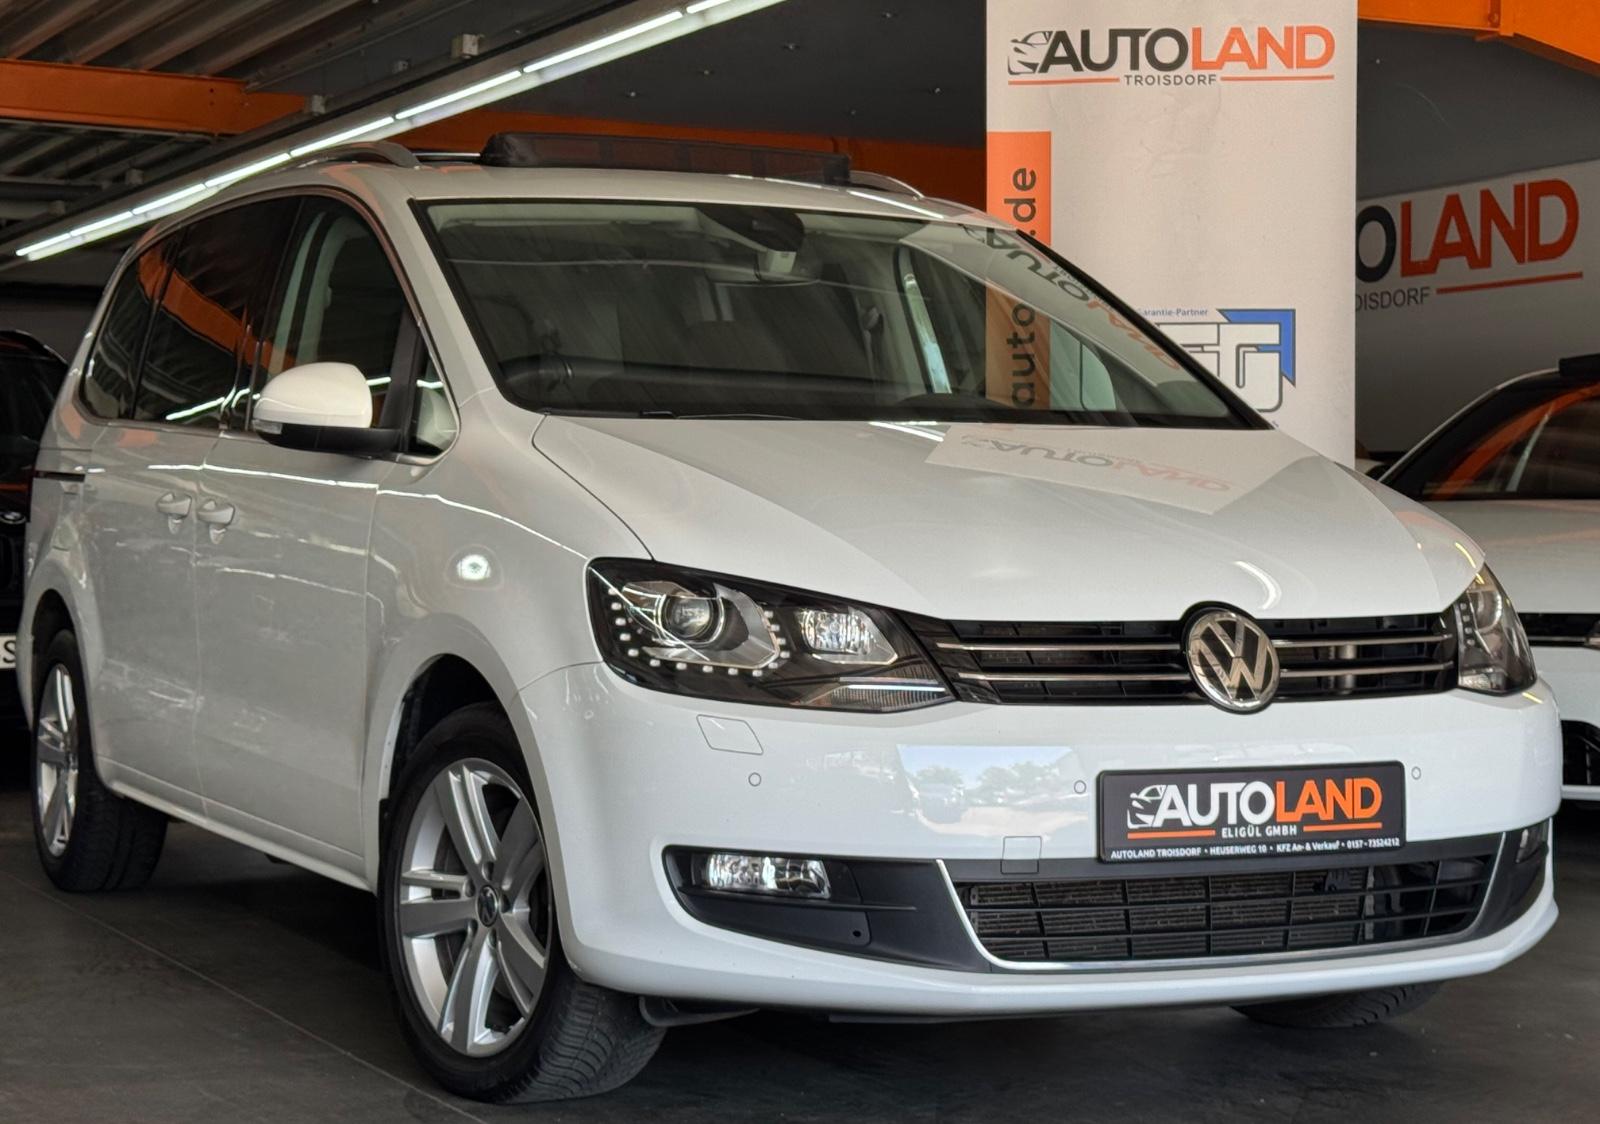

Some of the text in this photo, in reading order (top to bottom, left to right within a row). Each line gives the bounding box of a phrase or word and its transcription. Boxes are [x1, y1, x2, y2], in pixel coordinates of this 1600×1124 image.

[1037, 25, 1336, 74] AUTOLAND
[1123, 74, 1218, 86] TROISDORF
[1140, 307, 1209, 317] arantie-Partner
[1152, 777, 1383, 828] AUTOLAND
[1221, 824, 1298, 839] ELIGÜL GMBH
[1110, 848, 1156, 860] AUTOLAND
[1156, 847, 1202, 858] TROISDORF
[1210, 845, 1257, 856] HEUSERWEG
[1258, 844, 1268, 854] 10
[1276, 843, 1292, 853] KFZ
[1305, 842, 1313, 852] &
[1312, 840, 1341, 851] Verkauf
